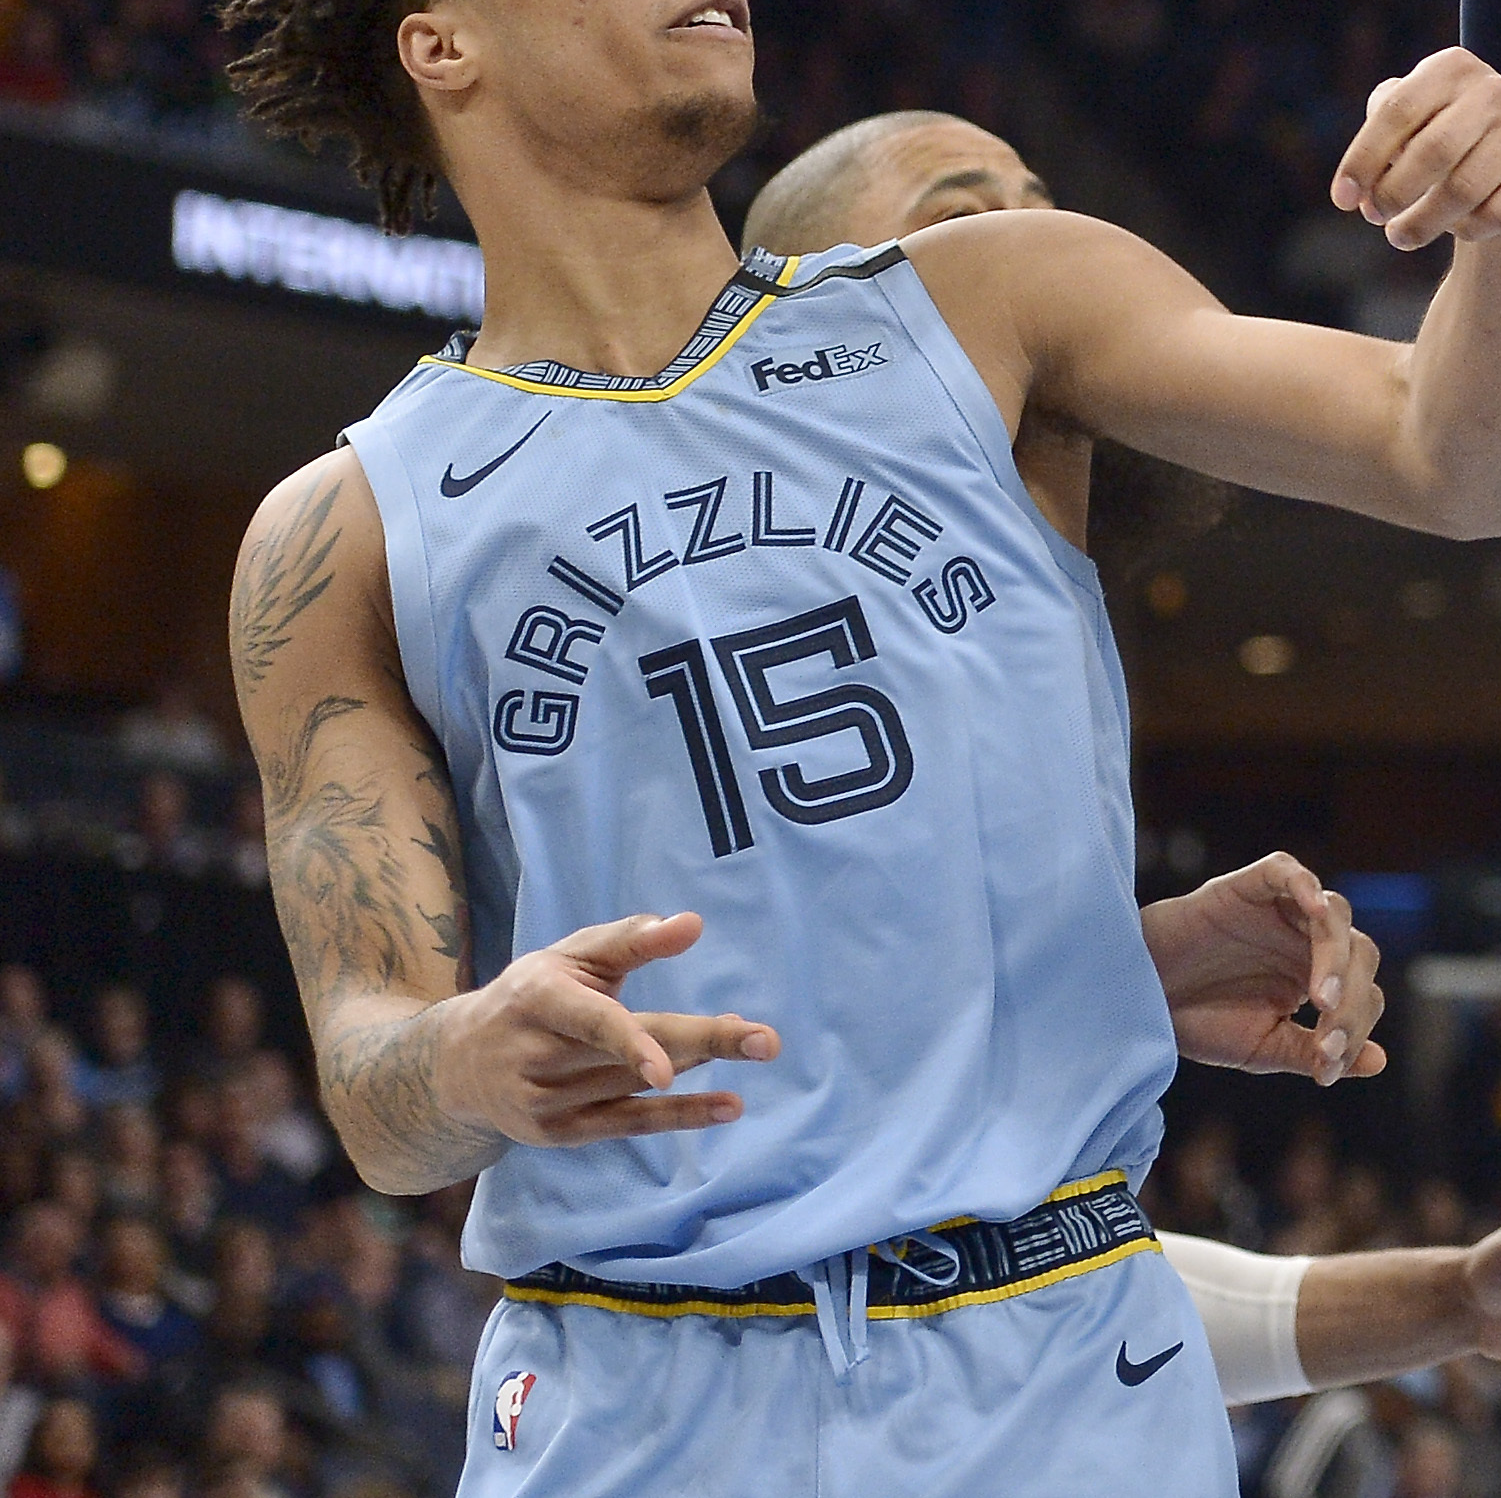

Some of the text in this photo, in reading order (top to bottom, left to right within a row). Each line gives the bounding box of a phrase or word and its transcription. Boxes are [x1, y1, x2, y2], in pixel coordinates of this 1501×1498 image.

[750, 342, 889, 392] FedEx
[493, 470, 996, 756] GRIZZLIES
[638, 594, 914, 857] 15
